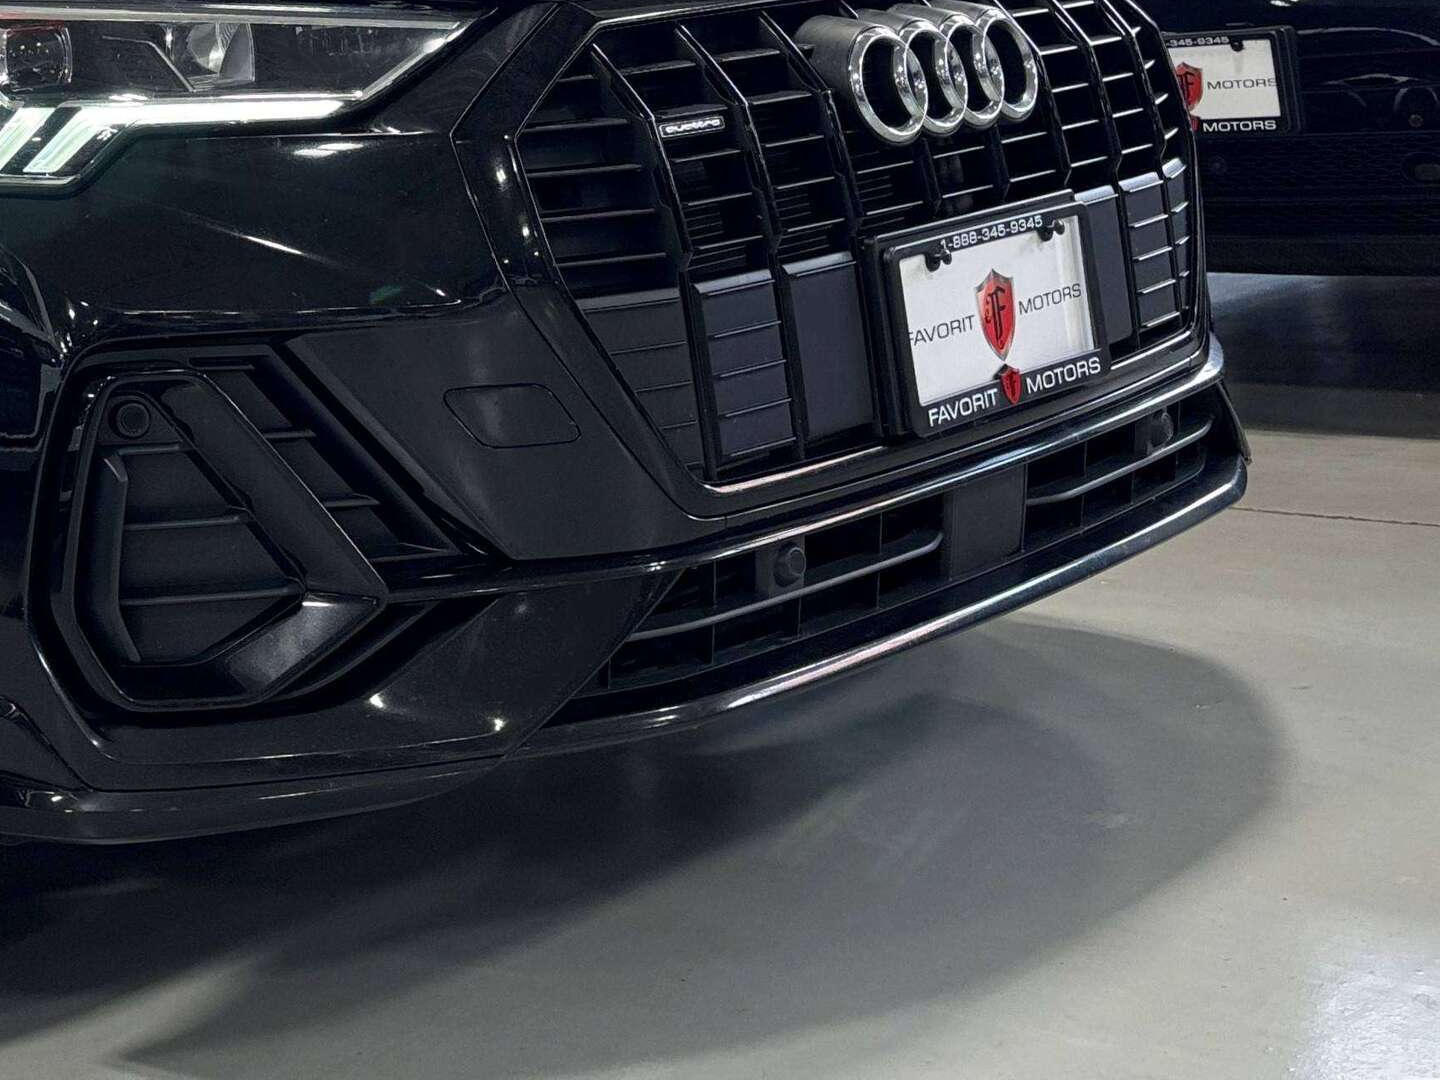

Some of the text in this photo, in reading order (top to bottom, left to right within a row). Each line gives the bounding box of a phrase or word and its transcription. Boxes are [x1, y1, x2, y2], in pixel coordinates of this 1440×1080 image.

[1207, 78, 1277, 90] MOTORS
[1202, 119, 1277, 133] MOTORS
[940, 214, 1043, 250] 1-888-345-9345
[1018, 283, 1082, 316] MOTORS
[927, 387, 998, 427] FAVORIT
[1026, 356, 1101, 395] MOTORS
